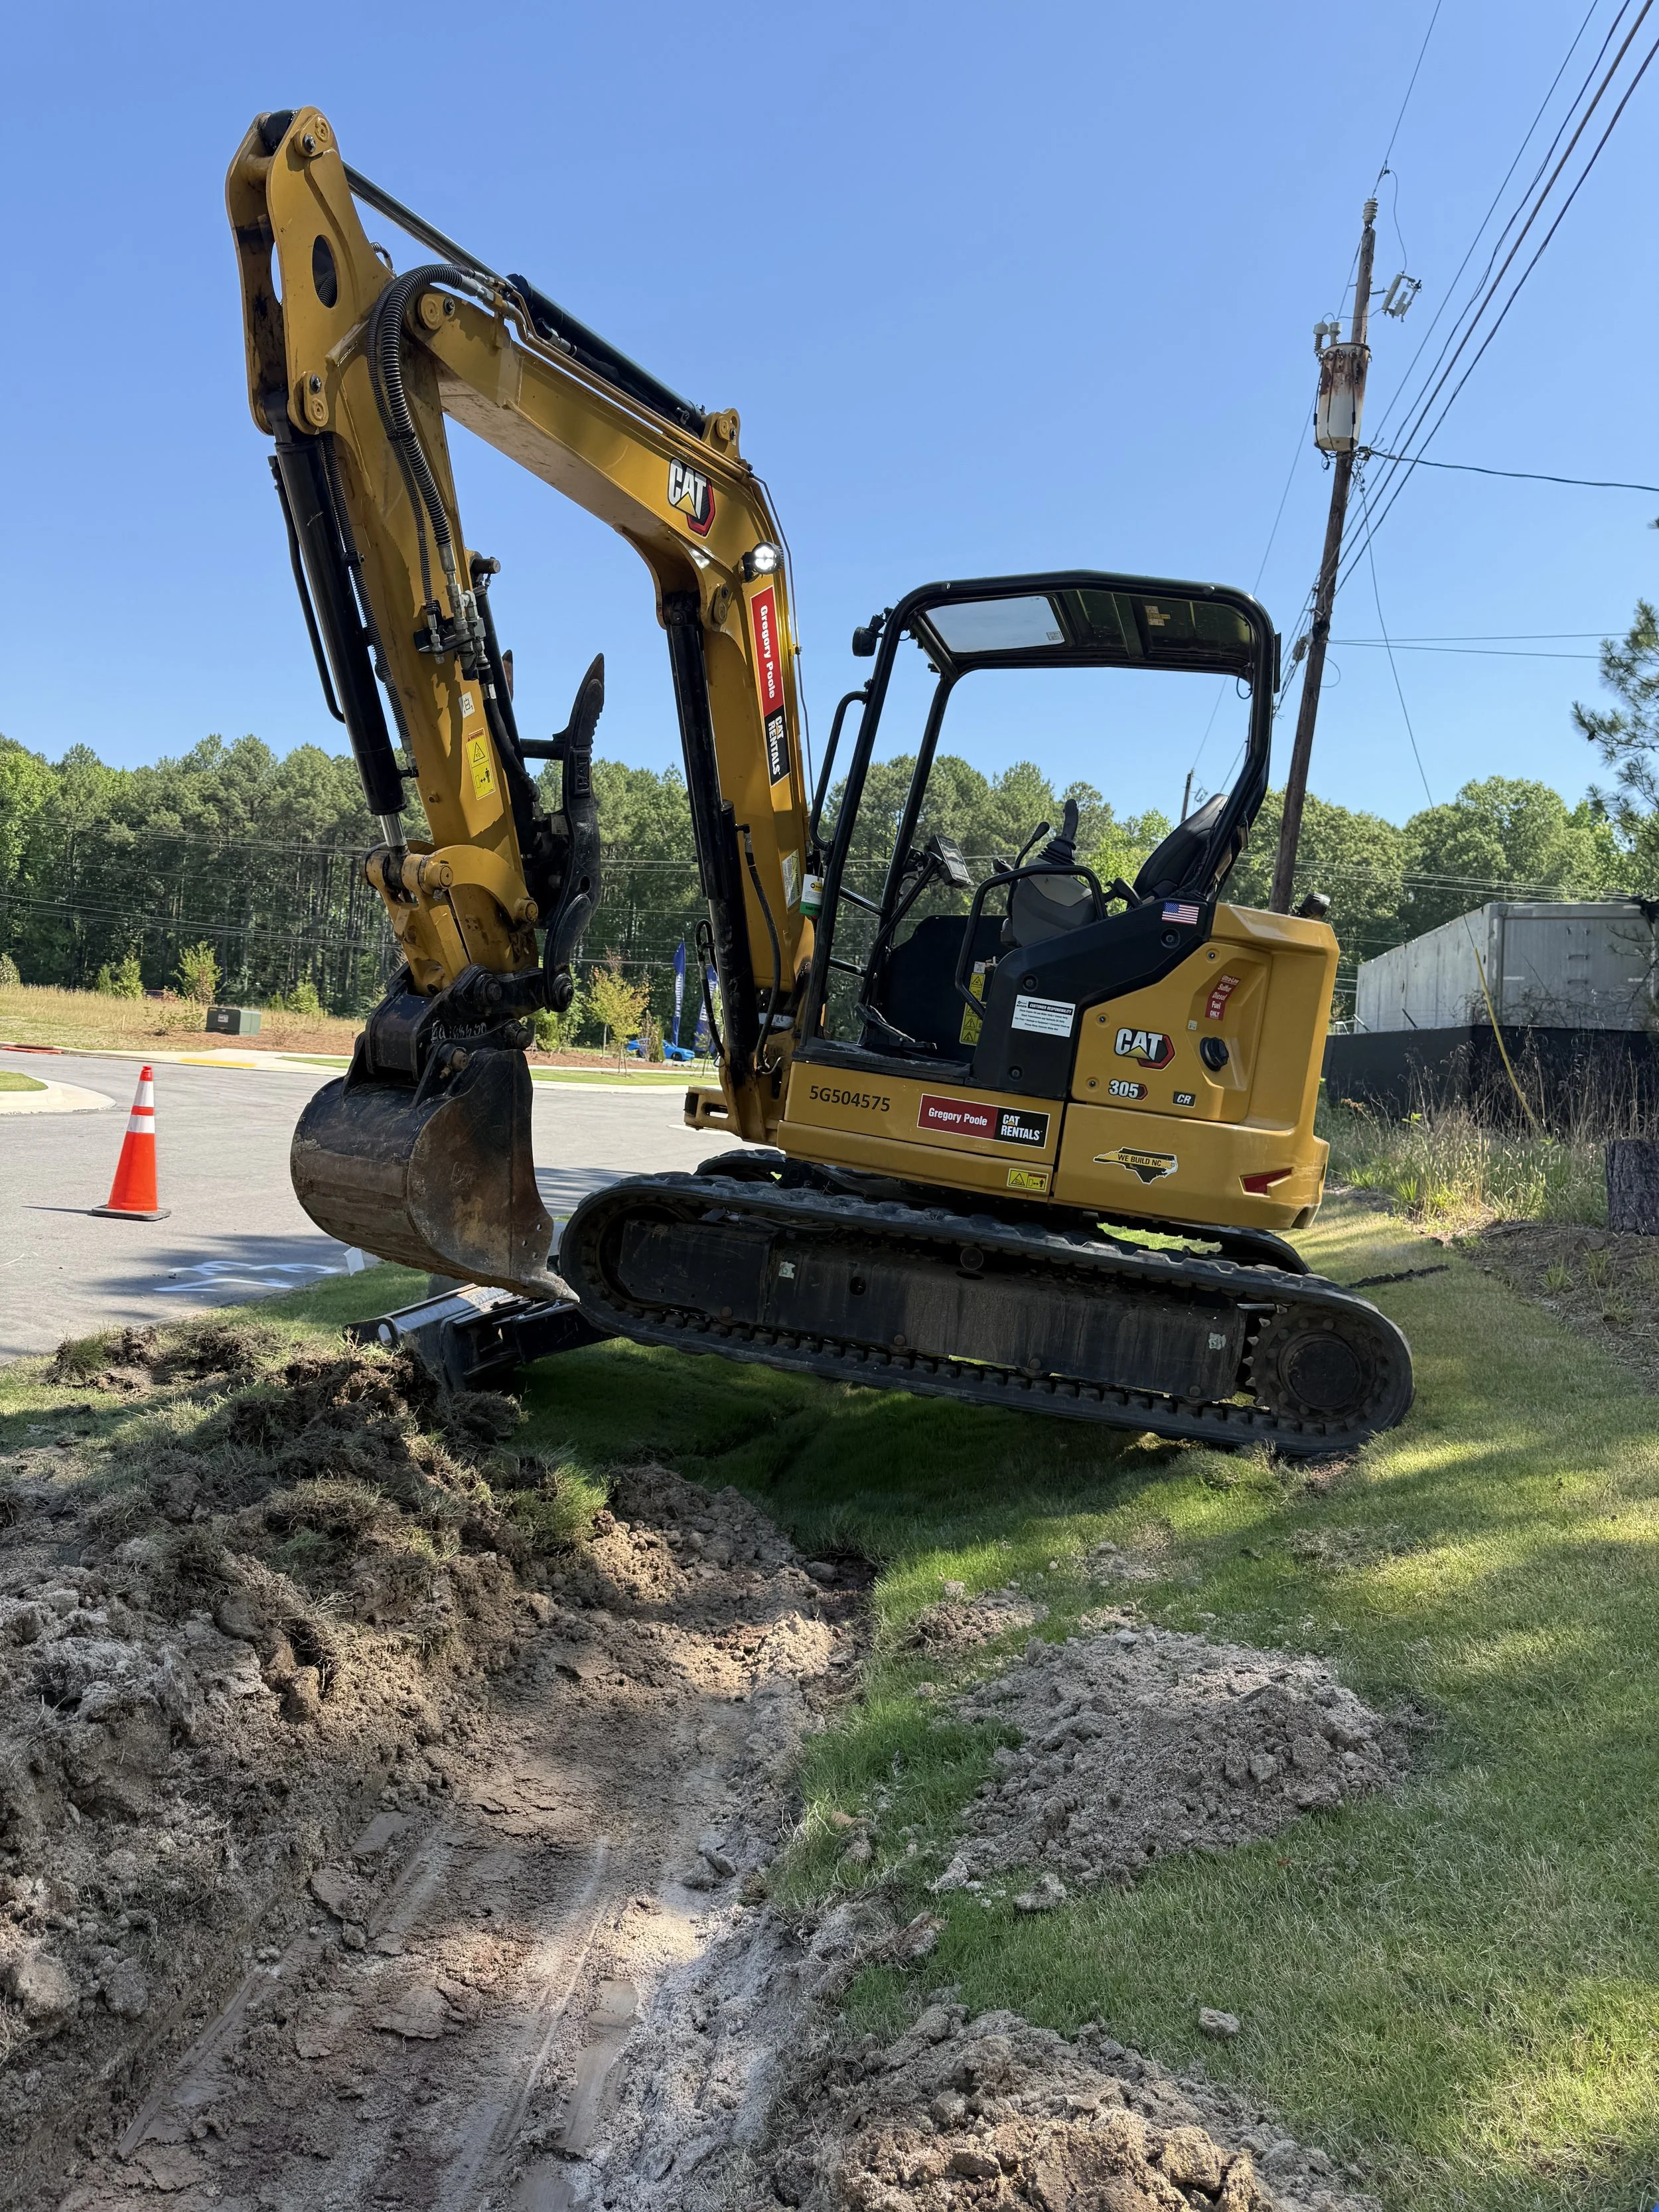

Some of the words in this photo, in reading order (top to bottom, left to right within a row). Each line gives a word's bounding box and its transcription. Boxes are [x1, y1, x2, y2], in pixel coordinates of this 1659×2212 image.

[669, 459, 707, 520] CAT
[760, 605, 771, 658] Gregory
[766, 661, 775, 699] Poole
[775, 715, 784, 740] CAT
[1211, 1001, 1221, 1009] Fuel
[1116, 1028, 1163, 1061] CAT
[809, 1085, 891, 1112] 5G504575
[1109, 1080, 1139, 1098] 305
[1177, 1094, 1191, 1104] CR
[928, 1107, 962, 1124] Gregory
[964, 1113, 987, 1126] Poole
[1003, 1114, 1020, 1126] CAT
[1118, 1153, 1129, 1162] WE
[1131, 1155, 1149, 1165] BUILD
